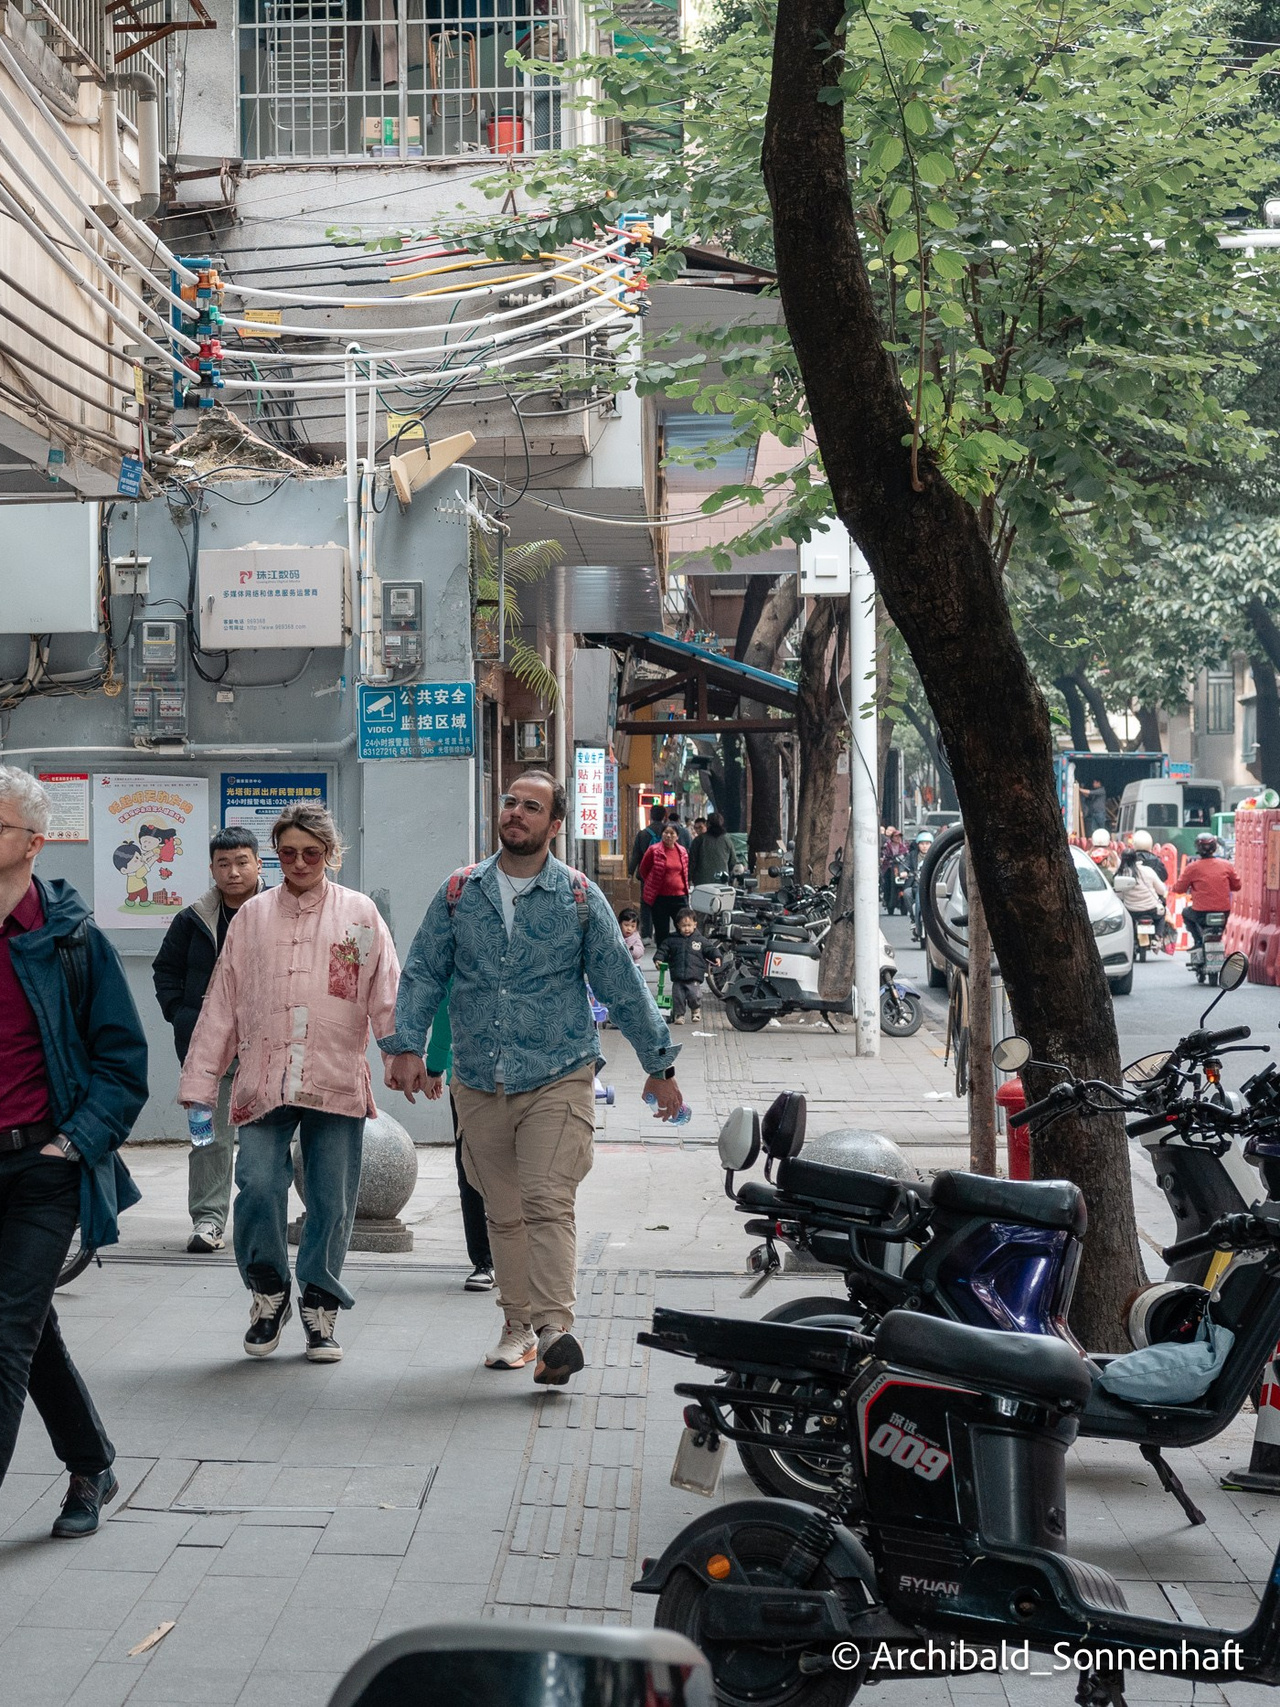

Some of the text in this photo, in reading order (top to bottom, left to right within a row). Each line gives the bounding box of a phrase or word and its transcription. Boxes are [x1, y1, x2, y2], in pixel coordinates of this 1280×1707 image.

[256, 570, 300, 580] 珠江数码
[223, 588, 318, 598] 多媒体网络和信息服务运营商
[400, 687, 466, 705] 公共安全
[401, 714, 467, 730] 监控区域
[363, 747, 397, 756] 83127216
[578, 752, 603, 763] 专业生产
[578, 769, 603, 780] 贴片
[226, 788, 321, 796] 光塔街派出所民警提醒您
[578, 783, 603, 793] 直插
[580, 796, 598, 835] 二极管
[861, 1375, 887, 1404] SYUAN
[889, 1412, 918, 1435] 深远
[869, 1423, 951, 1481] 009
[900, 1575, 960, 1595] SYUAN
